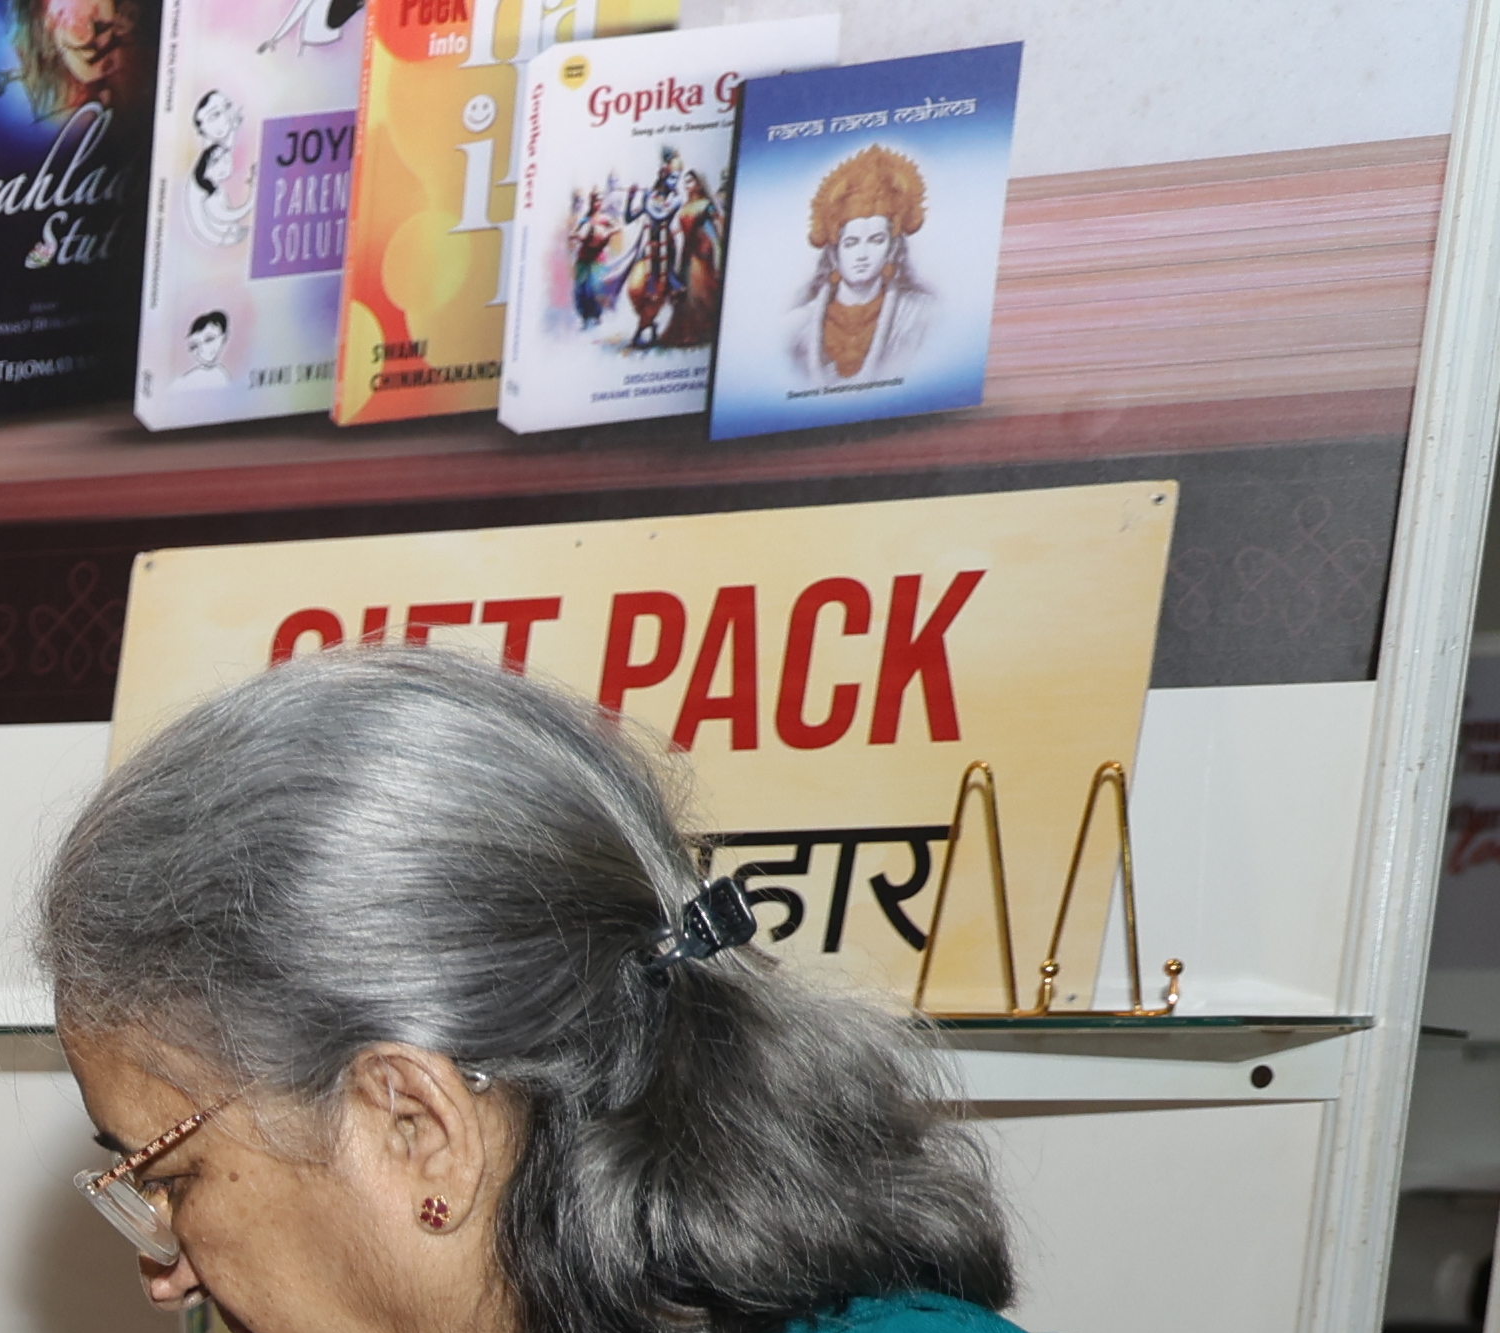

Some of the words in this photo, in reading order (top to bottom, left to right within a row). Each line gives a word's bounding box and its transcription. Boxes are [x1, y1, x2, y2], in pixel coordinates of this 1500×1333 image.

[428, 31, 469, 58] into
[525, 82, 545, 158] Gopika
[588, 76, 704, 128] Gopika
[766, 116, 825, 142] rama
[829, 109, 888, 134] nama
[893, 97, 977, 127] mahima
[276, 126, 357, 167] JOY
[370, 338, 428, 364] SWAMI
[598, 568, 987, 752] PACK
